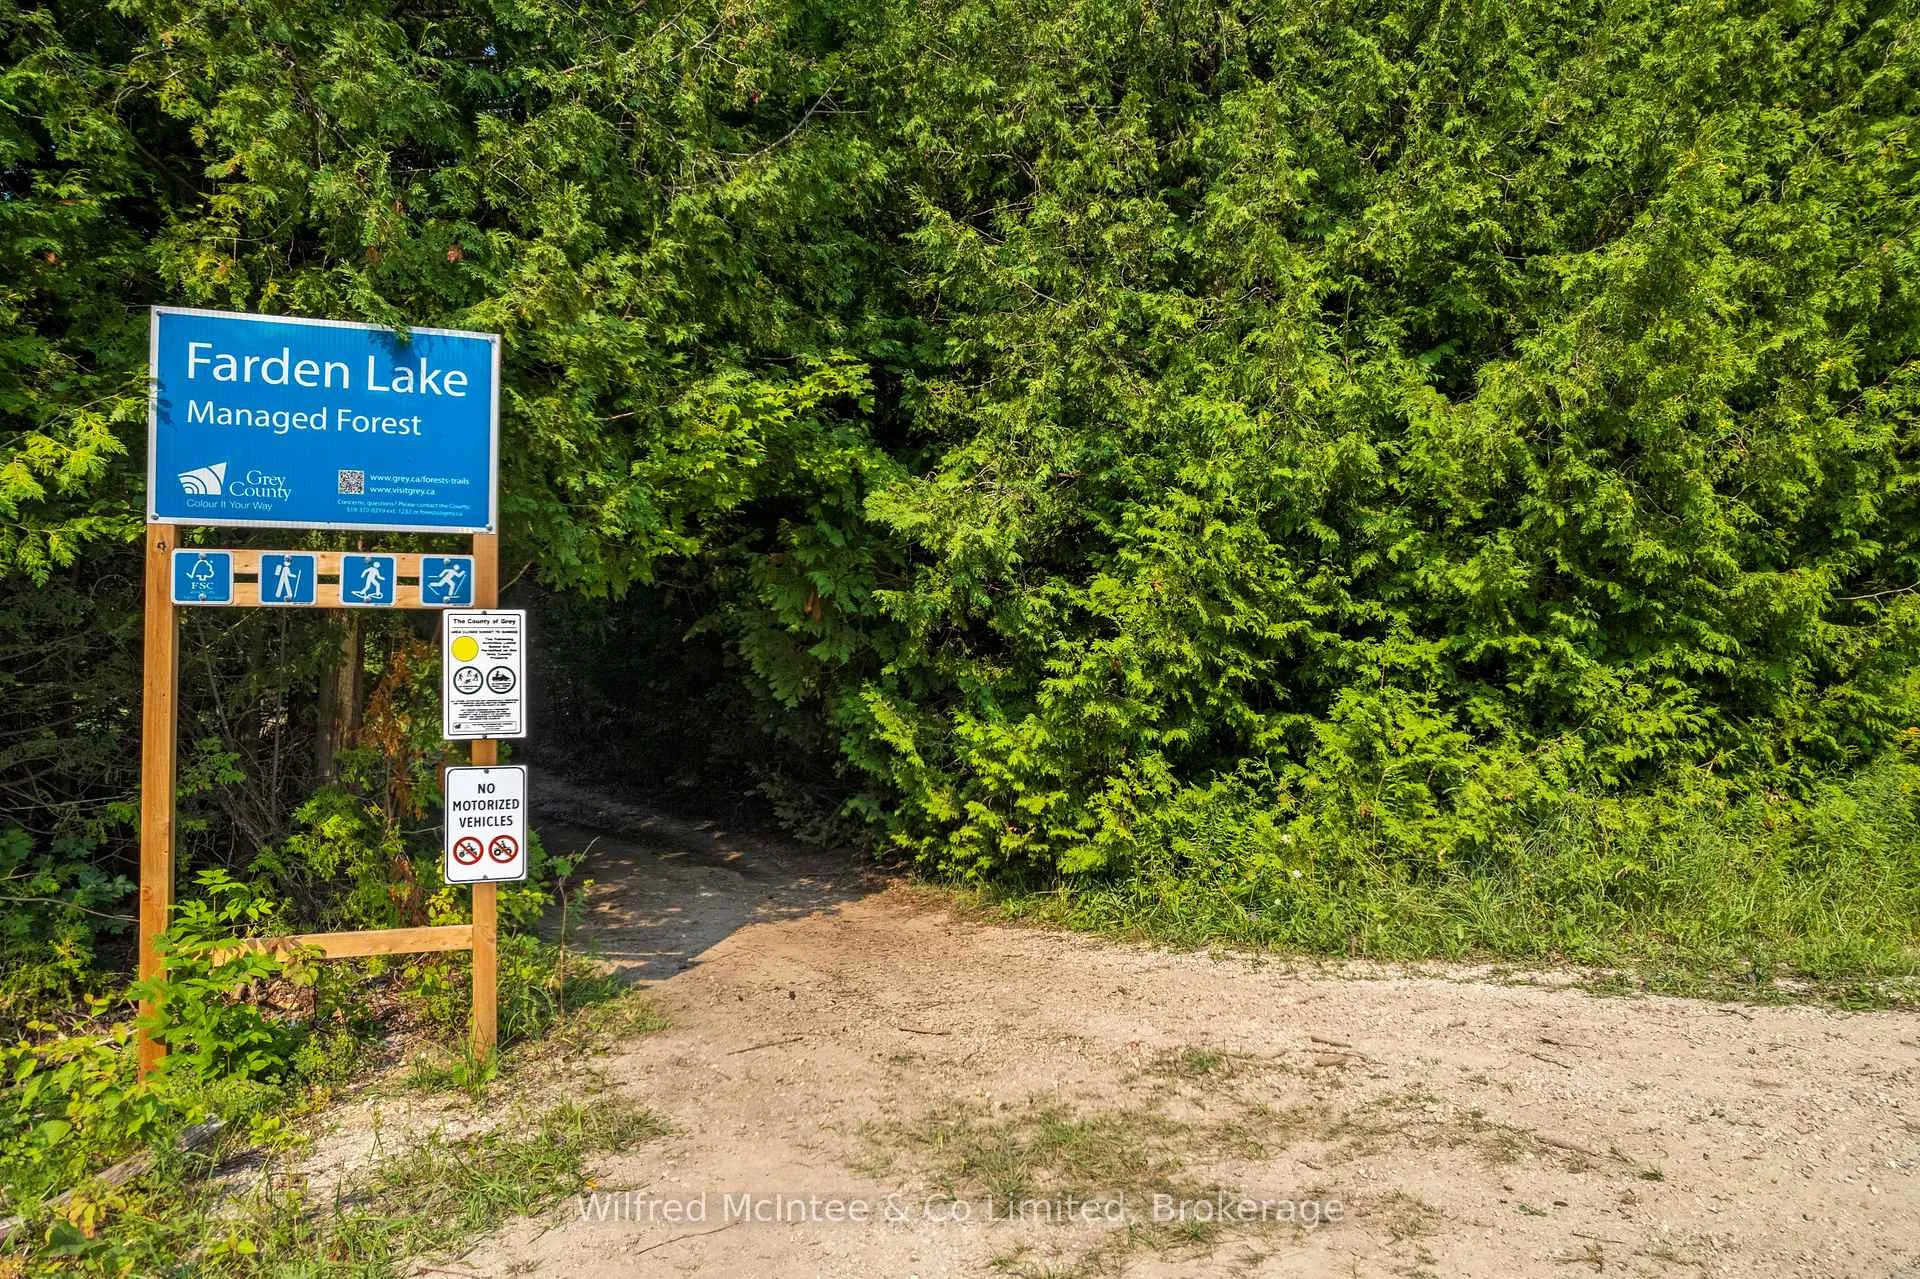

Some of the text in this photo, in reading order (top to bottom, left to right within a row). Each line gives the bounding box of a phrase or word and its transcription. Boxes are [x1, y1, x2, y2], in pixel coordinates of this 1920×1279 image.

[187, 341, 468, 397] Farden Lake
[187, 399, 422, 436] Managed Forest
[246, 470, 286, 489] Grey
[229, 481, 292, 502] County
[370, 486, 436, 497] www.visitgrey.ca
[186, 499, 218, 508] Colour
[230, 500, 250, 510] Your
[253, 501, 273, 513] Way
[191, 582, 214, 590] FSC
[477, 783, 496, 794] NO
[453, 798, 520, 812] MOTORIZED
[459, 815, 513, 828] VEHICLES
